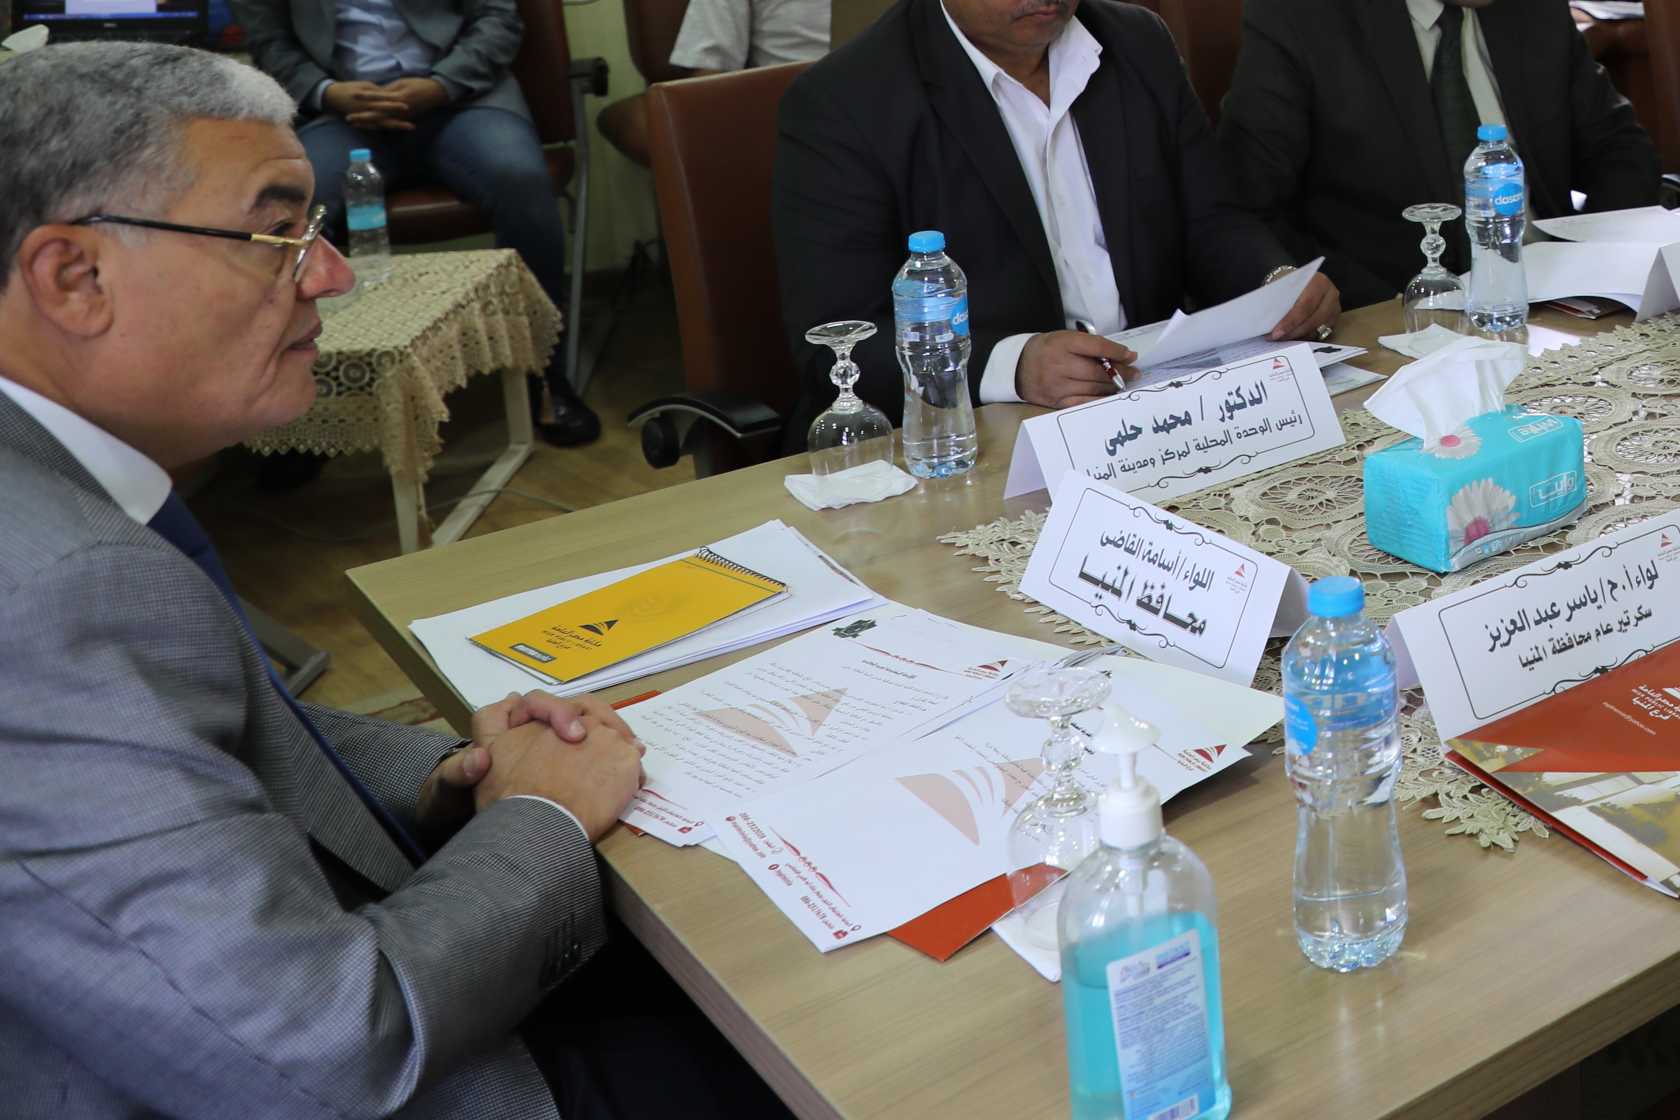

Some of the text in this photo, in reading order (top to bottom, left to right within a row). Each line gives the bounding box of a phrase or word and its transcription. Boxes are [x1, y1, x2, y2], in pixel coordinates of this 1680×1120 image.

[1218, 380, 1268, 423] الدكتور
[1151, 408, 1193, 435] محمد
[1236, 417, 1272, 441] الوحدة
[1276, 409, 1303, 432] رئيس
[1161, 440, 1191, 466] لمركز
[1194, 430, 1233, 454] المحلية
[1120, 453, 1156, 474] ومدينة
[1183, 561, 1215, 592] اللواء
[1634, 559, 1660, 590] لواء
[1077, 553, 1207, 636] محافظ المنيا
[1566, 587, 1602, 622] ياسر
[1534, 601, 1561, 630] عبد
[1482, 608, 1531, 653] العزيز
[1594, 621, 1613, 644] عام
[1551, 631, 1592, 658] محافظة
[1518, 645, 1548, 673] المنيا
